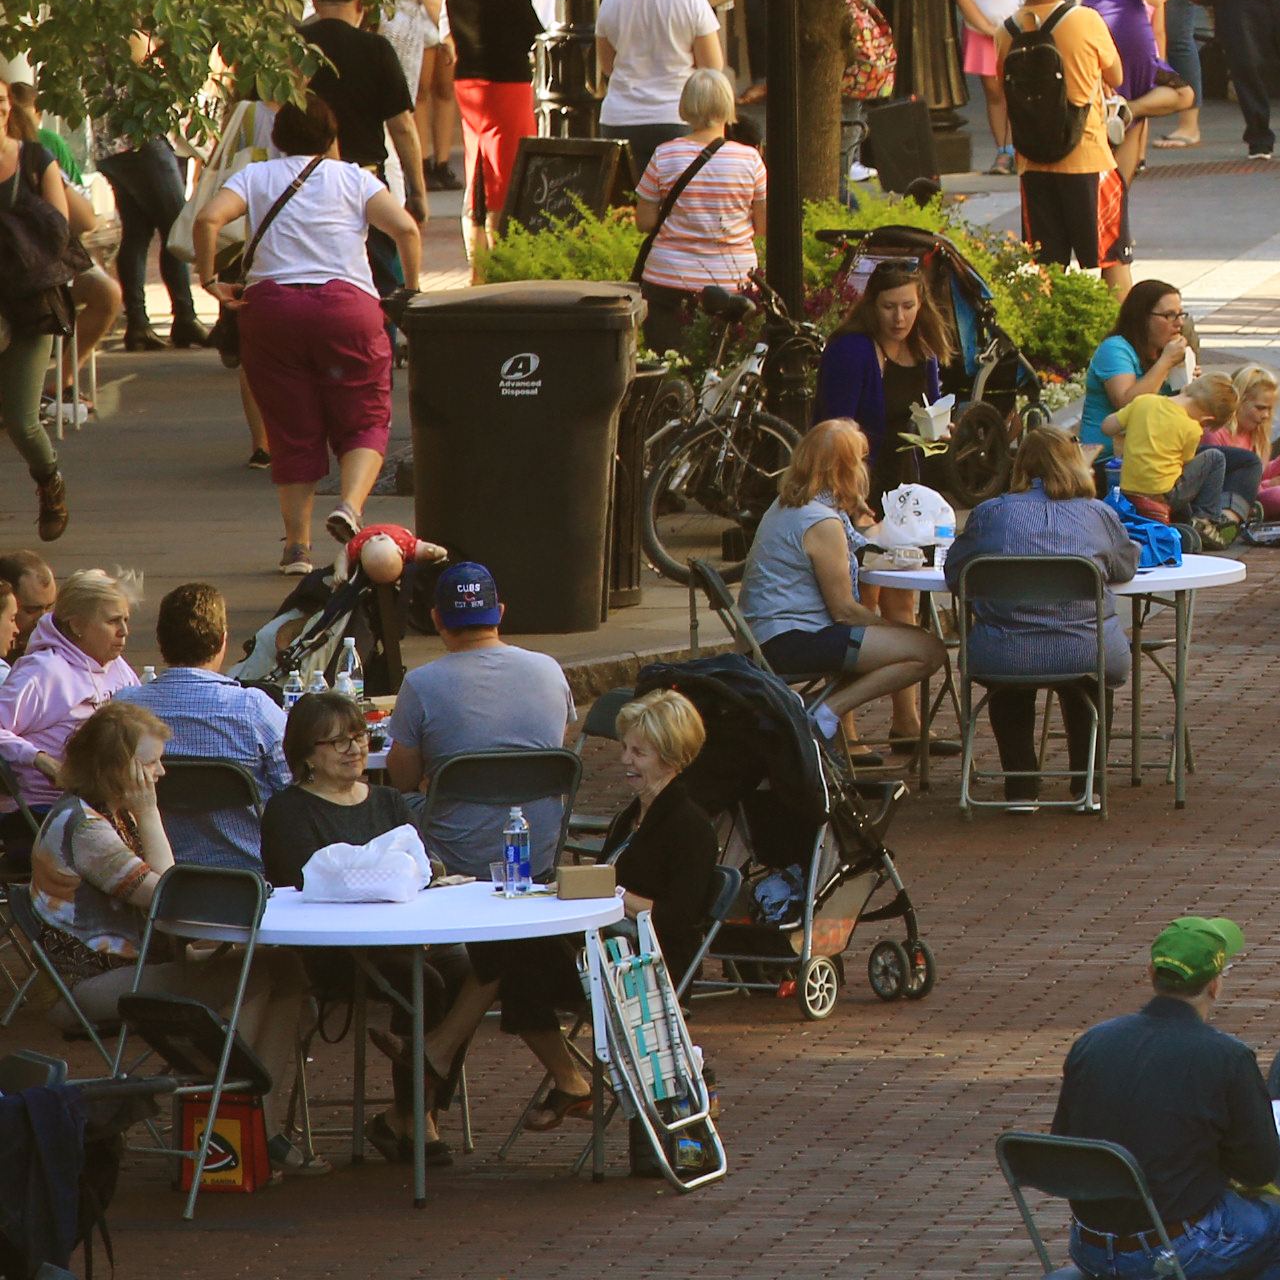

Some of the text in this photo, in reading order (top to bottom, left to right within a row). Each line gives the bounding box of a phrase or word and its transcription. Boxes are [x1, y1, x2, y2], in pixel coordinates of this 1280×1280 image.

[499, 380, 542, 388] Advanced
[501, 388, 538, 397] Disposal
[457, 584, 480, 593] CUBS
